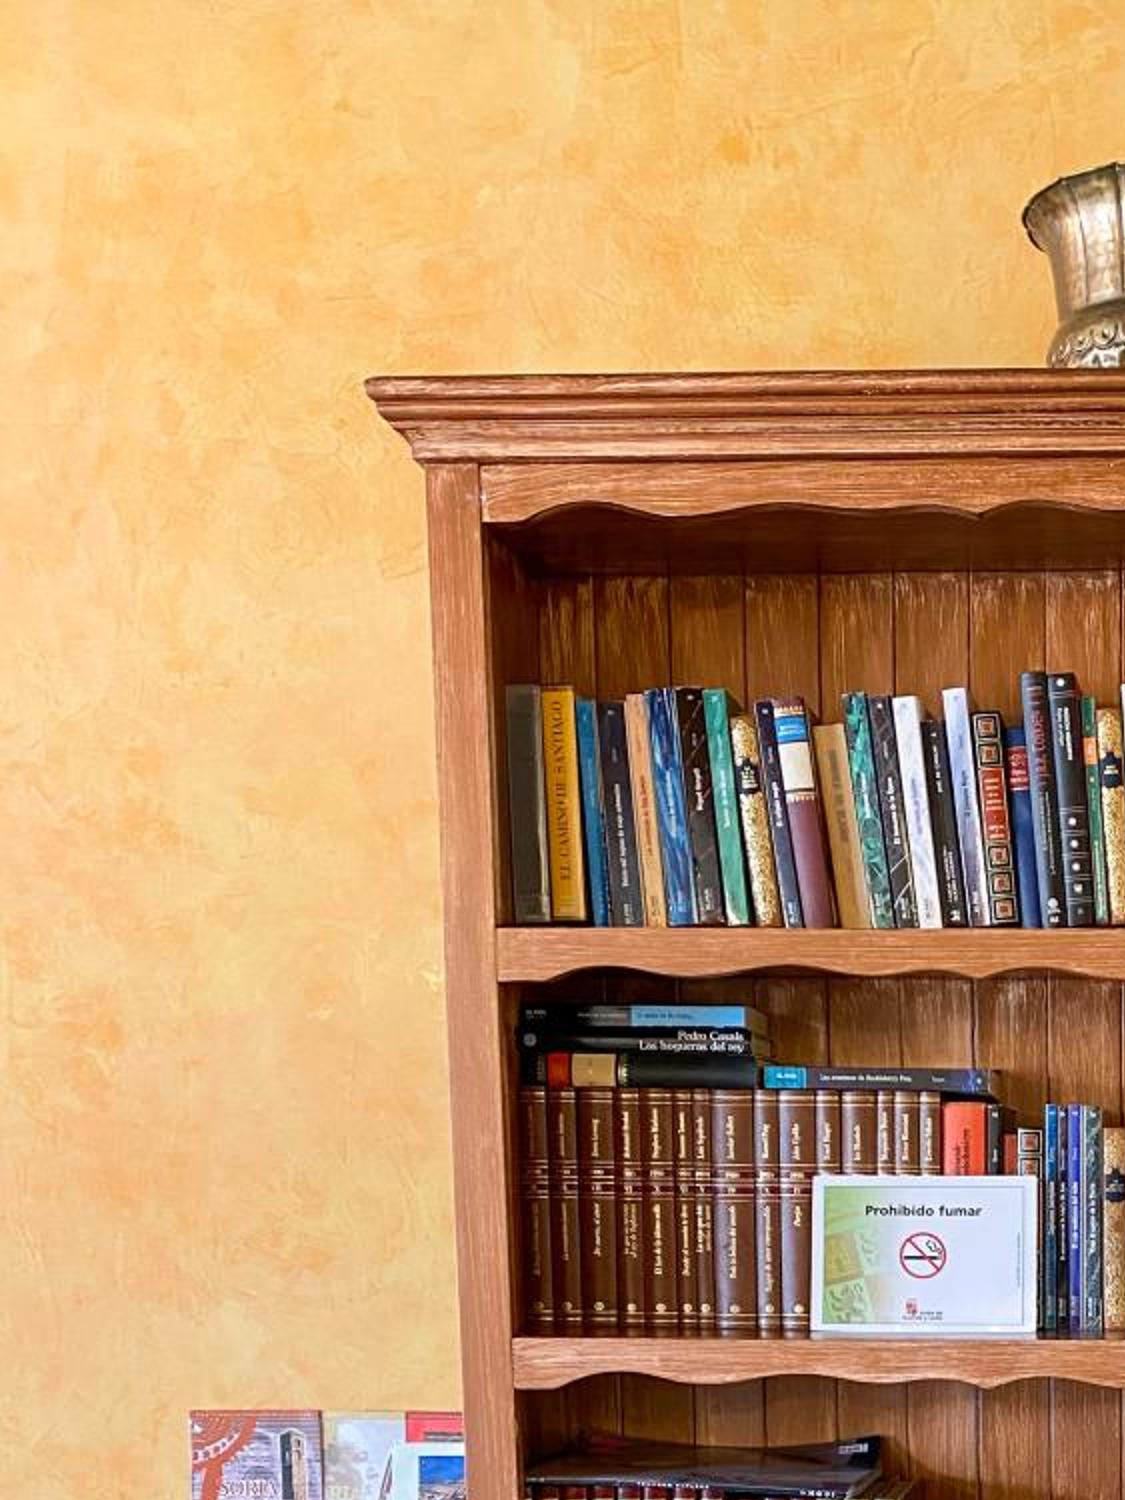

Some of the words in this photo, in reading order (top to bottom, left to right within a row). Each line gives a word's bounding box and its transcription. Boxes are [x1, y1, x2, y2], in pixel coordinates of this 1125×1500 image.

[550, 700, 565, 774] SANTIAGO
[555, 783, 567, 798] DE
[556, 802, 570, 858] CAMINO
[559, 863, 571, 881] EL
[677, 1030, 707, 1042] Pedro
[709, 1031, 745, 1042] Casals
[659, 1040, 708, 1052] hogueras
[710, 1041, 727, 1051] del
[728, 1043, 745, 1054] rey
[864, 1204, 935, 1218] Prohibido
[938, 1204, 983, 1217] fumar
